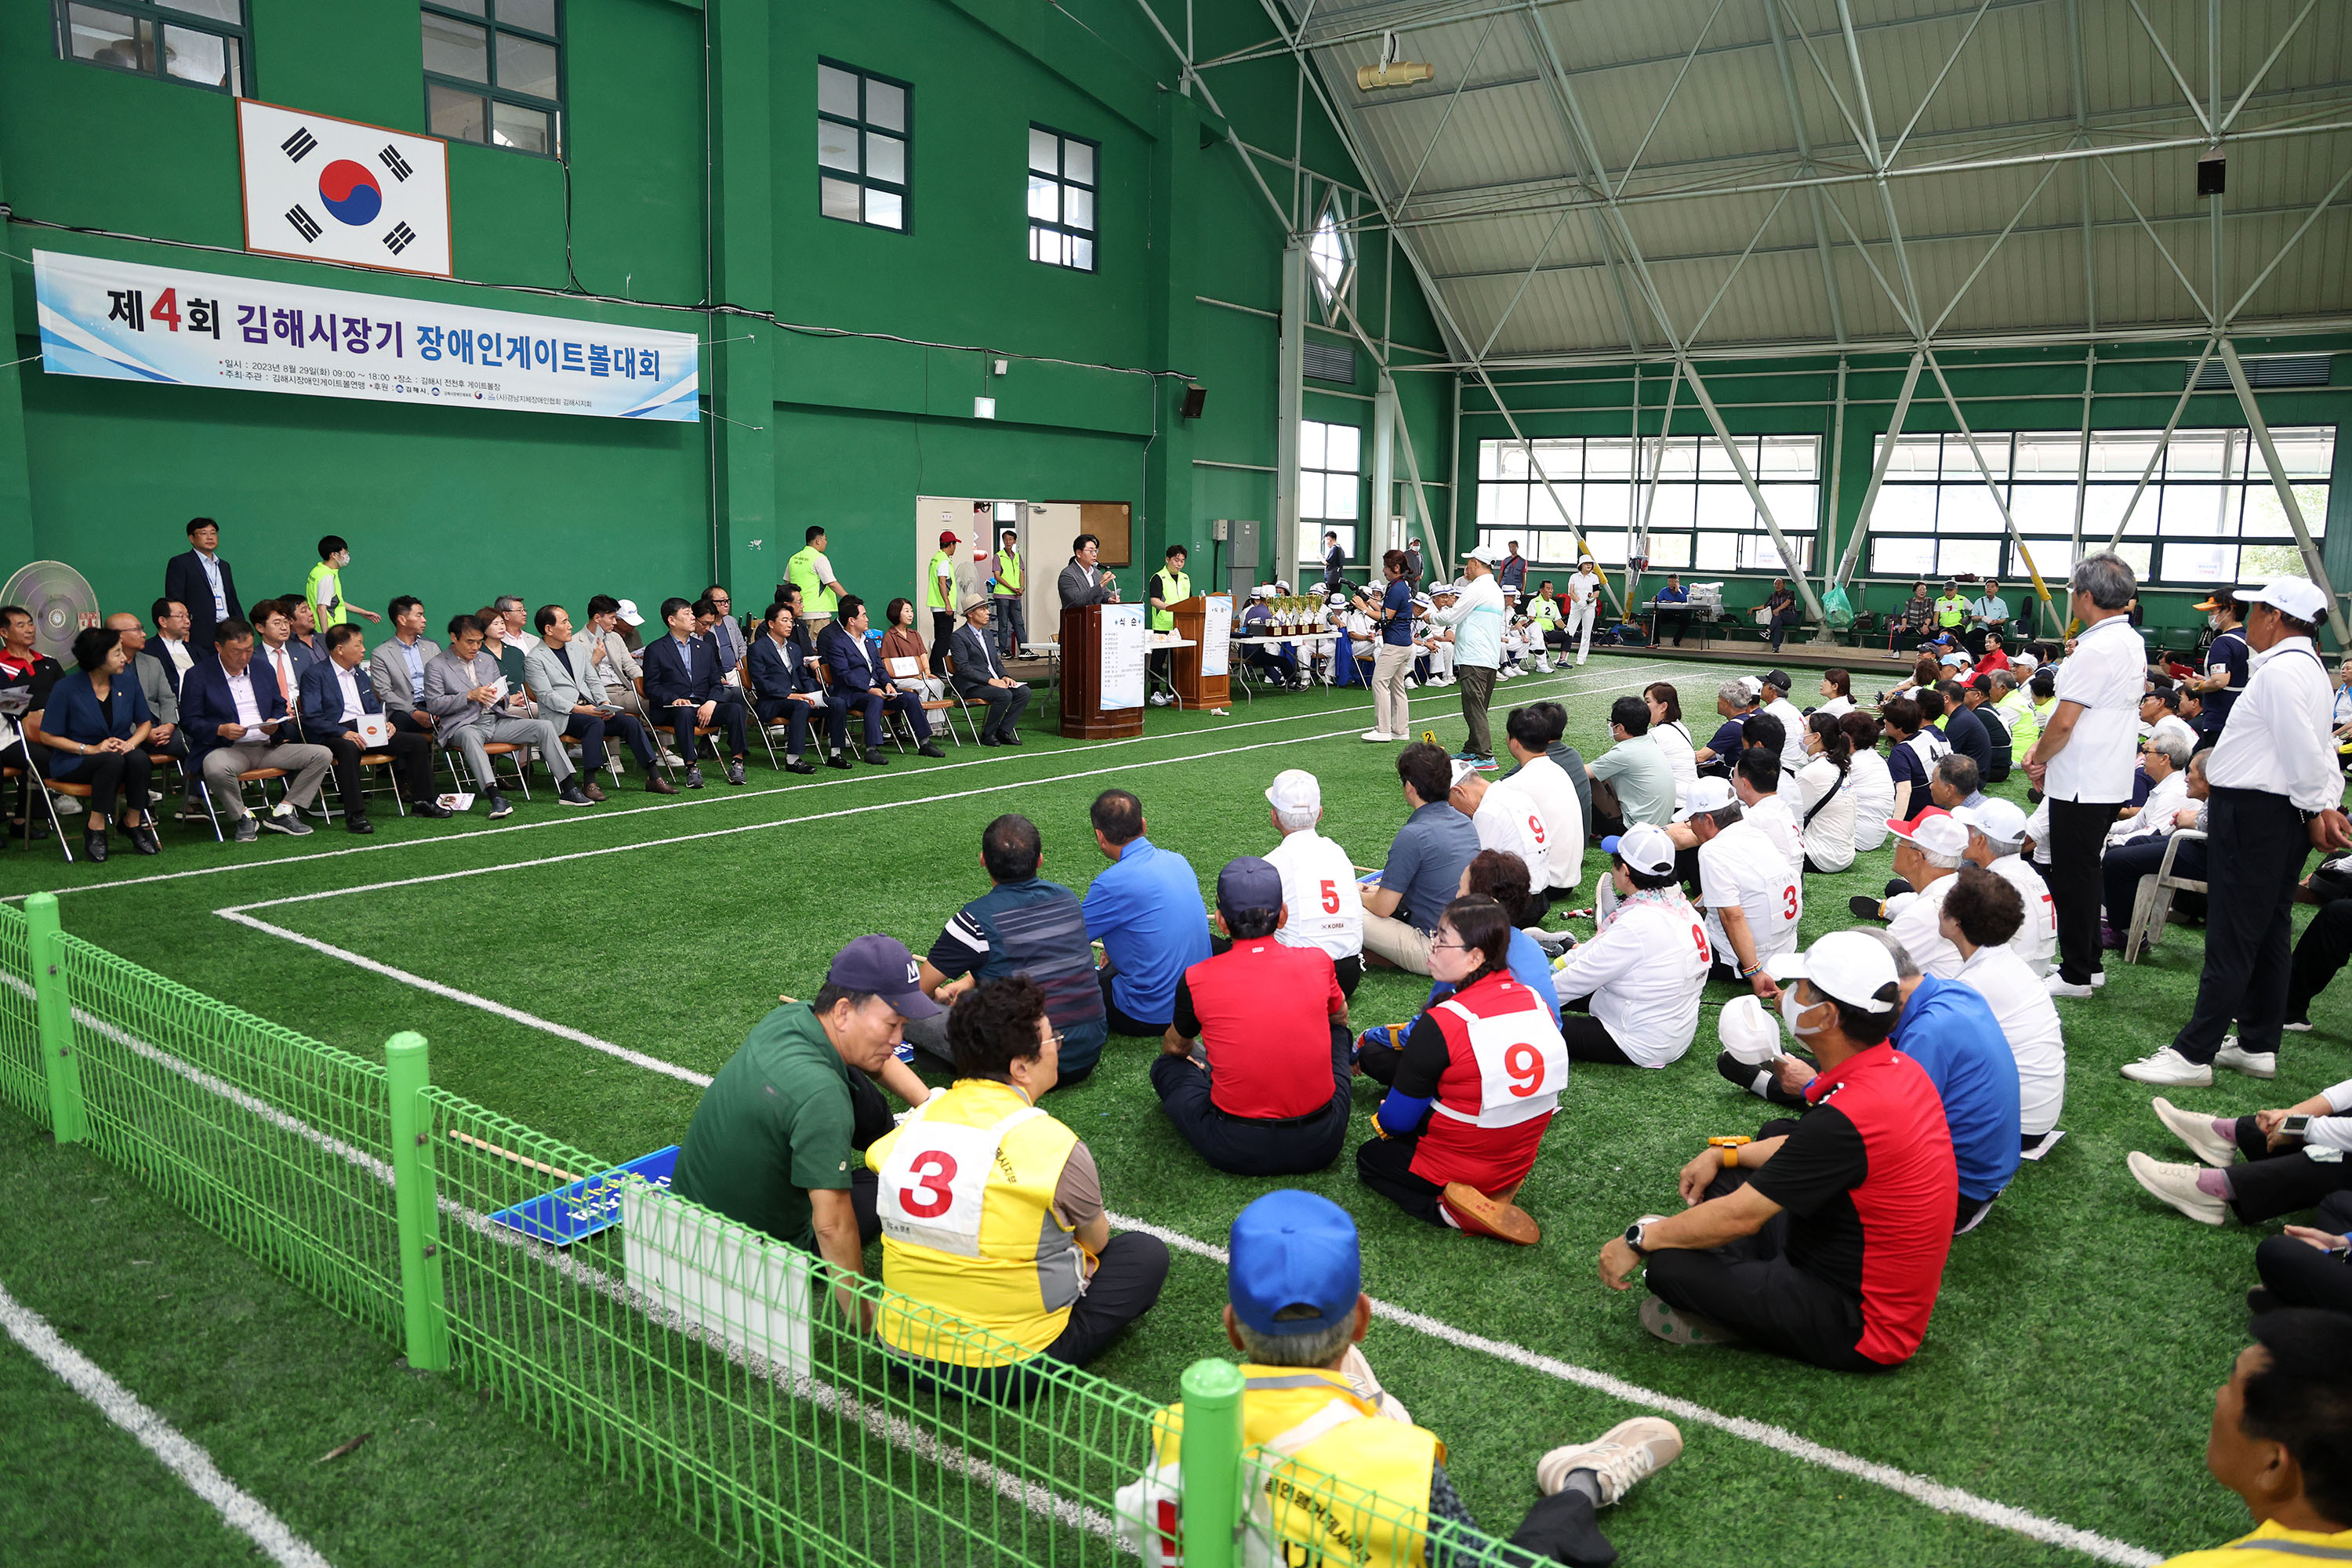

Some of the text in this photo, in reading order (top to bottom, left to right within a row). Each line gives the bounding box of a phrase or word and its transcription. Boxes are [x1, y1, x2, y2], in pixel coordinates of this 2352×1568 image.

[107, 286, 660, 383] 제4회 김해시장기 장애인게이트볼대회
[225, 359, 242, 369] 일시
[252, 361, 280, 372] 2023년
[282, 364, 296, 374] 8월
[299, 366, 330, 377] 29일(화)
[332, 369, 356, 379] 09:00
[368, 372, 390, 382] 18:00
[397, 375, 413, 384] 장소
[421, 376, 443, 387] 김해시
[444, 379, 465, 388] 전천후
[467, 380, 501, 391] 게이트볼장
[272, 373, 366, 390] 김해시장애인게이트볼연맹
[373, 382, 389, 392] 후원
[495, 393, 561, 405] (사)경남지체장애인협회
[563, 397, 593, 408] 김해시지회
[1544, 606, 1551, 615] 2
[1425, 732, 1433, 743] 2
[1528, 815, 1545, 844] 9
[1319, 880, 1340, 915] 5
[1783, 885, 1798, 920] 3
[1691, 924, 1710, 963] 9
[1504, 1042, 1545, 1098] 9
[898, 1149, 958, 1218] 3
